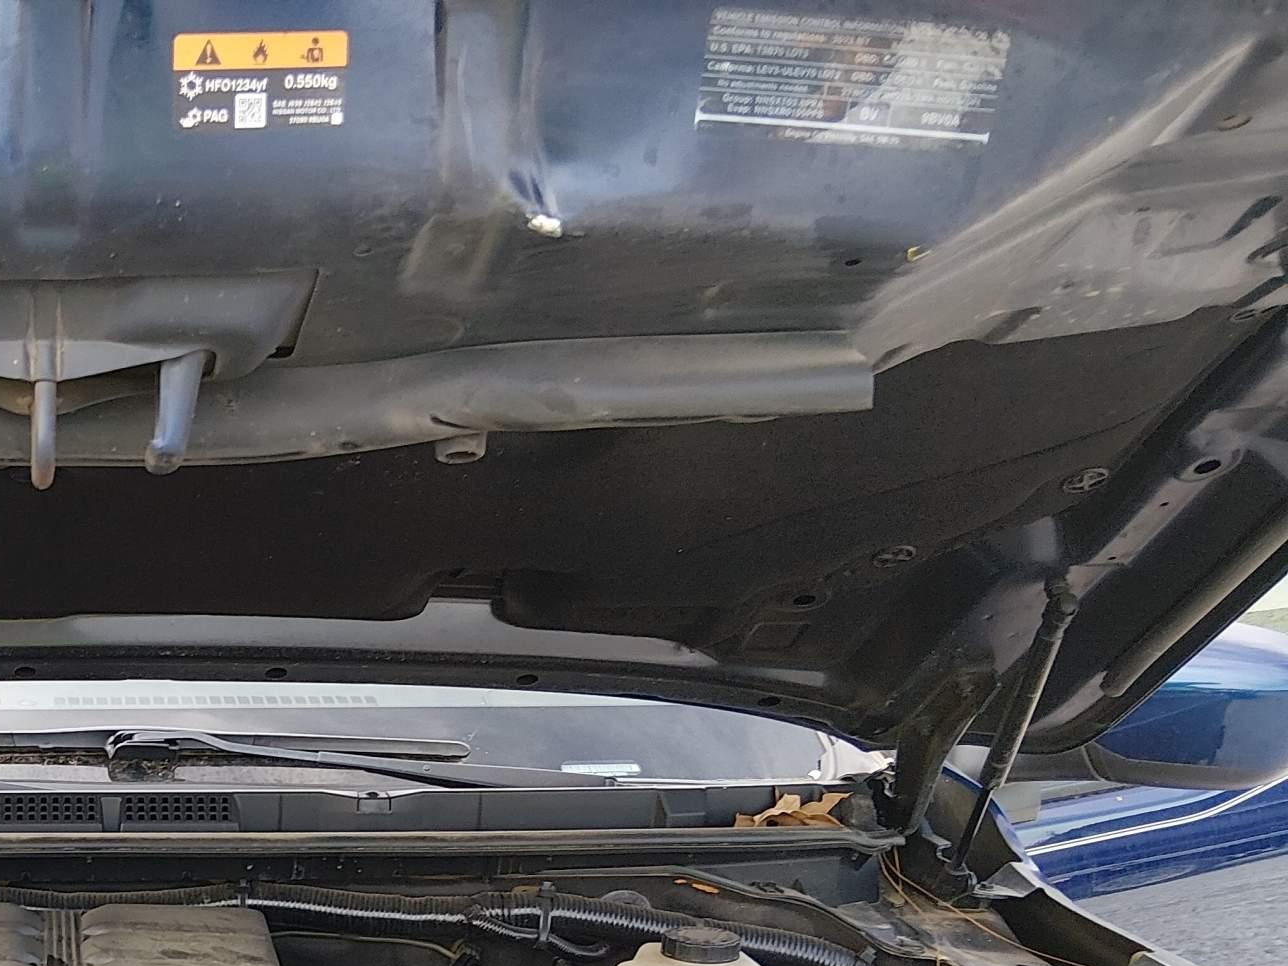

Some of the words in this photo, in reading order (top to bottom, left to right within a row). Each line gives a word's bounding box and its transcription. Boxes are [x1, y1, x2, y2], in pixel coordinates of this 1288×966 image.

[205, 77, 269, 93] HFO1234yf
[284, 74, 338, 90] 0.550kg
[203, 109, 228, 122] PAG
